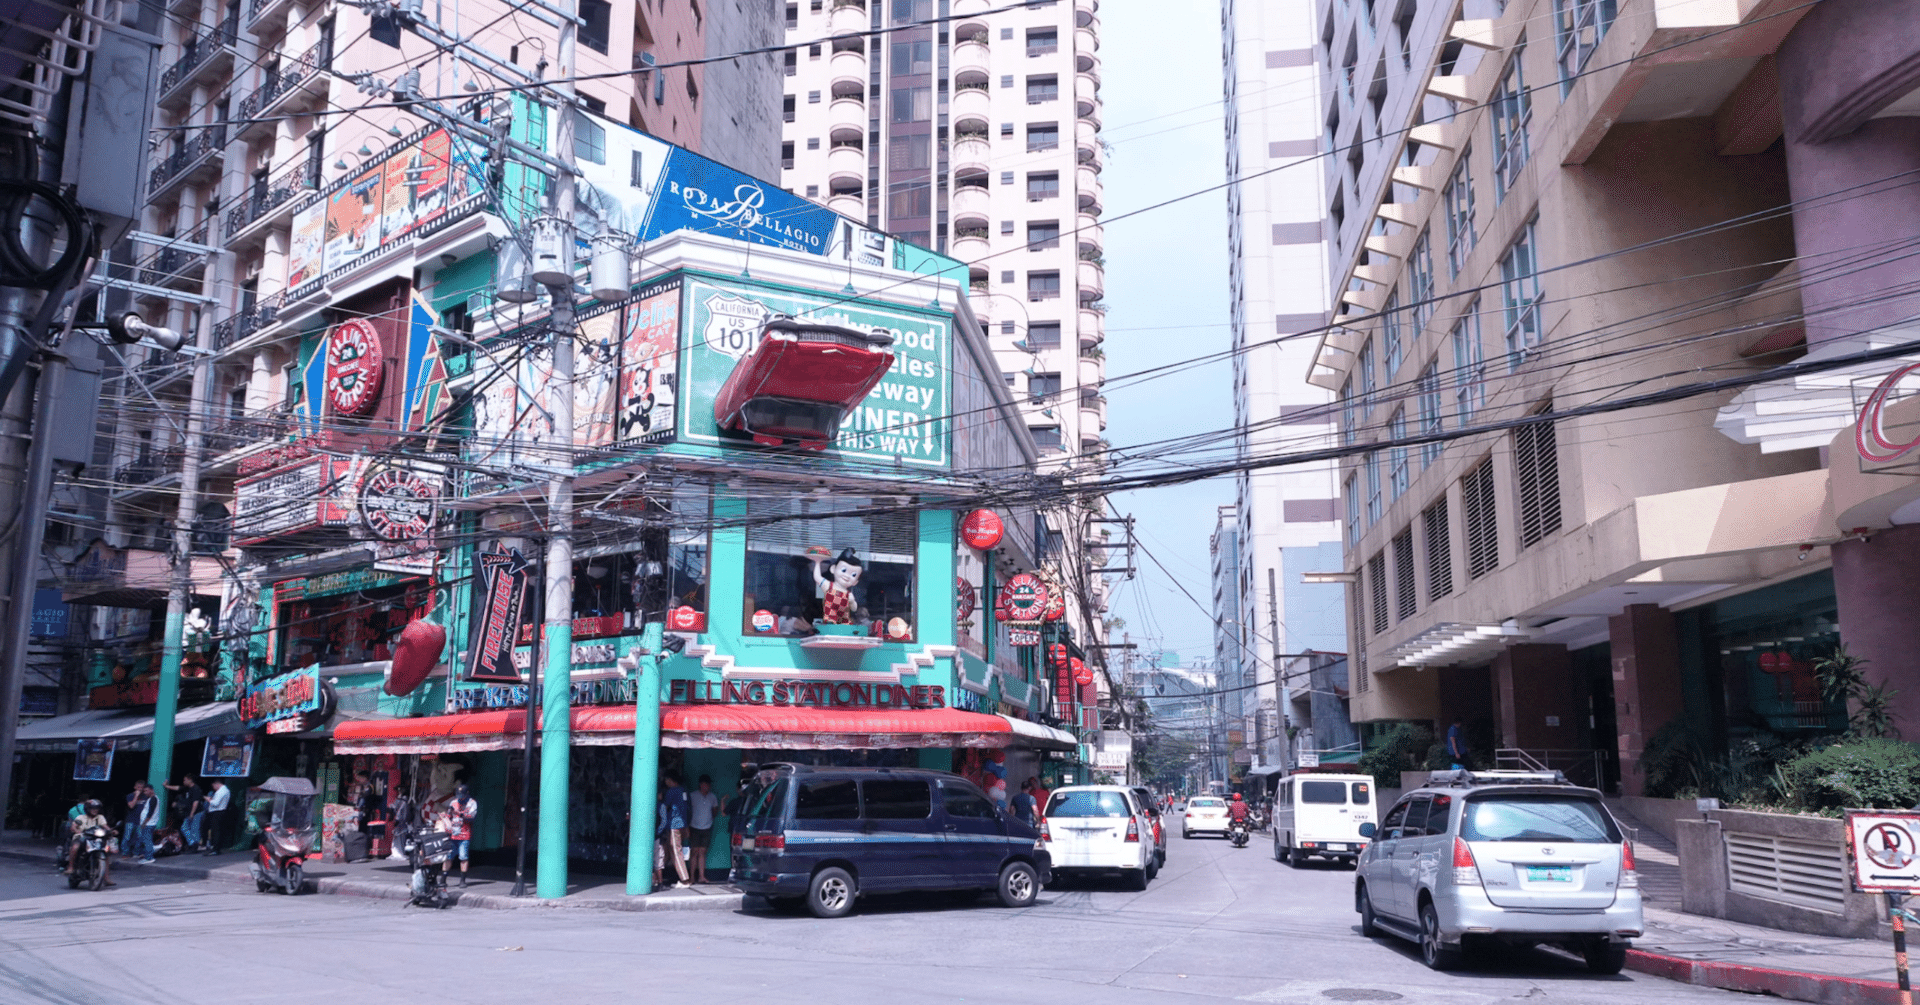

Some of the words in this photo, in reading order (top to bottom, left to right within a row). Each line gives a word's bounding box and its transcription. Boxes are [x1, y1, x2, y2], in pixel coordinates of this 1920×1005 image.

[671, 181, 732, 214] ROYAL
[744, 208, 819, 247] BELLAGIO
[626, 300, 677, 341] Felix
[715, 301, 760, 318] CALIFORNIA
[728, 317, 745, 328] US
[648, 323, 671, 339] CAT
[720, 328, 754, 352] 101
[329, 329, 368, 366] FILLING
[888, 351, 936, 379] eles
[329, 368, 369, 406] STATION
[868, 381, 935, 411] eway
[837, 431, 875, 449] THIS
[880, 436, 919, 455] WAY
[370, 471, 432, 497] FILLING
[368, 510, 428, 539] STATION
[1005, 577, 1043, 596] FILLING
[481, 568, 514, 673] FIREHOUSE
[1004, 598, 1044, 617] STATION
[1015, 633, 1034, 642] OPEN
[454, 683, 529, 709] BREAKFAS
[593, 679, 638, 703] DINNE
[670, 680, 766, 705] FILLING
[771, 680, 874, 707] STATION
[876, 684, 946, 708] DINER
